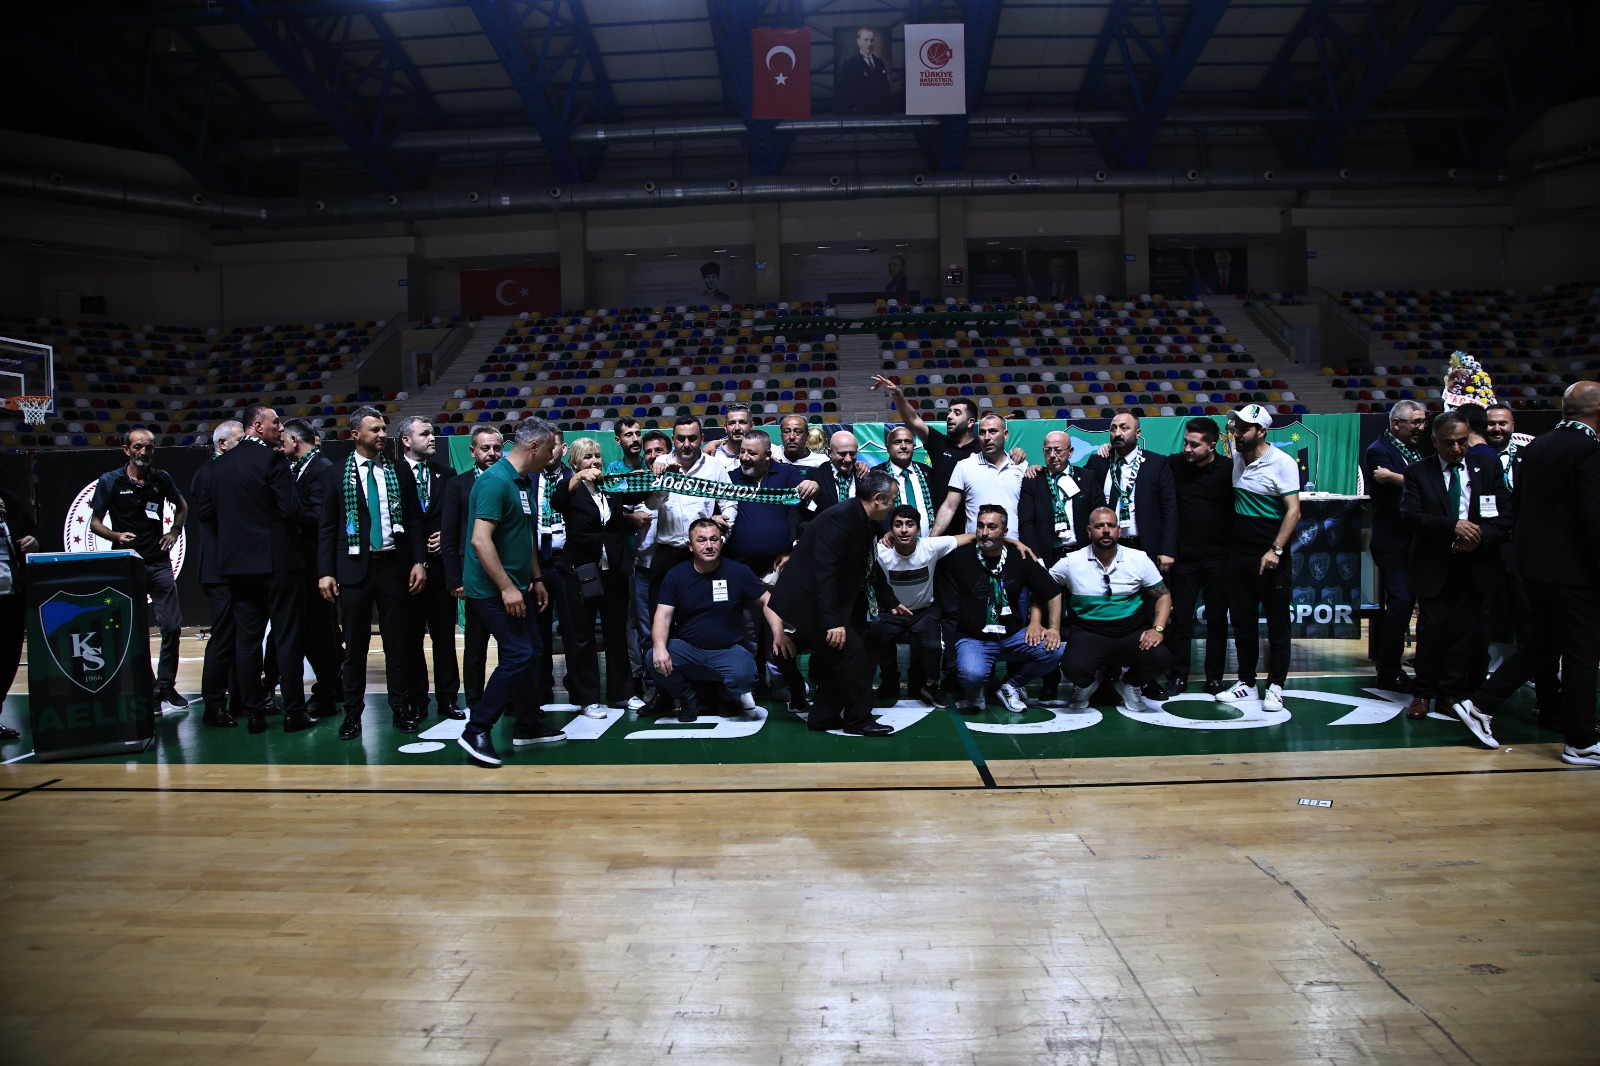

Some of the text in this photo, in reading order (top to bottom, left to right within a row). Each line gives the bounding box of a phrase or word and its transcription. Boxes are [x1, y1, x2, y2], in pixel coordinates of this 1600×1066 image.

[651, 475, 759, 499] KOCAELİSPOR
[70, 631, 105, 671] KS
[85, 674, 103, 683] 1966
[33, 694, 150, 733] AELİS
